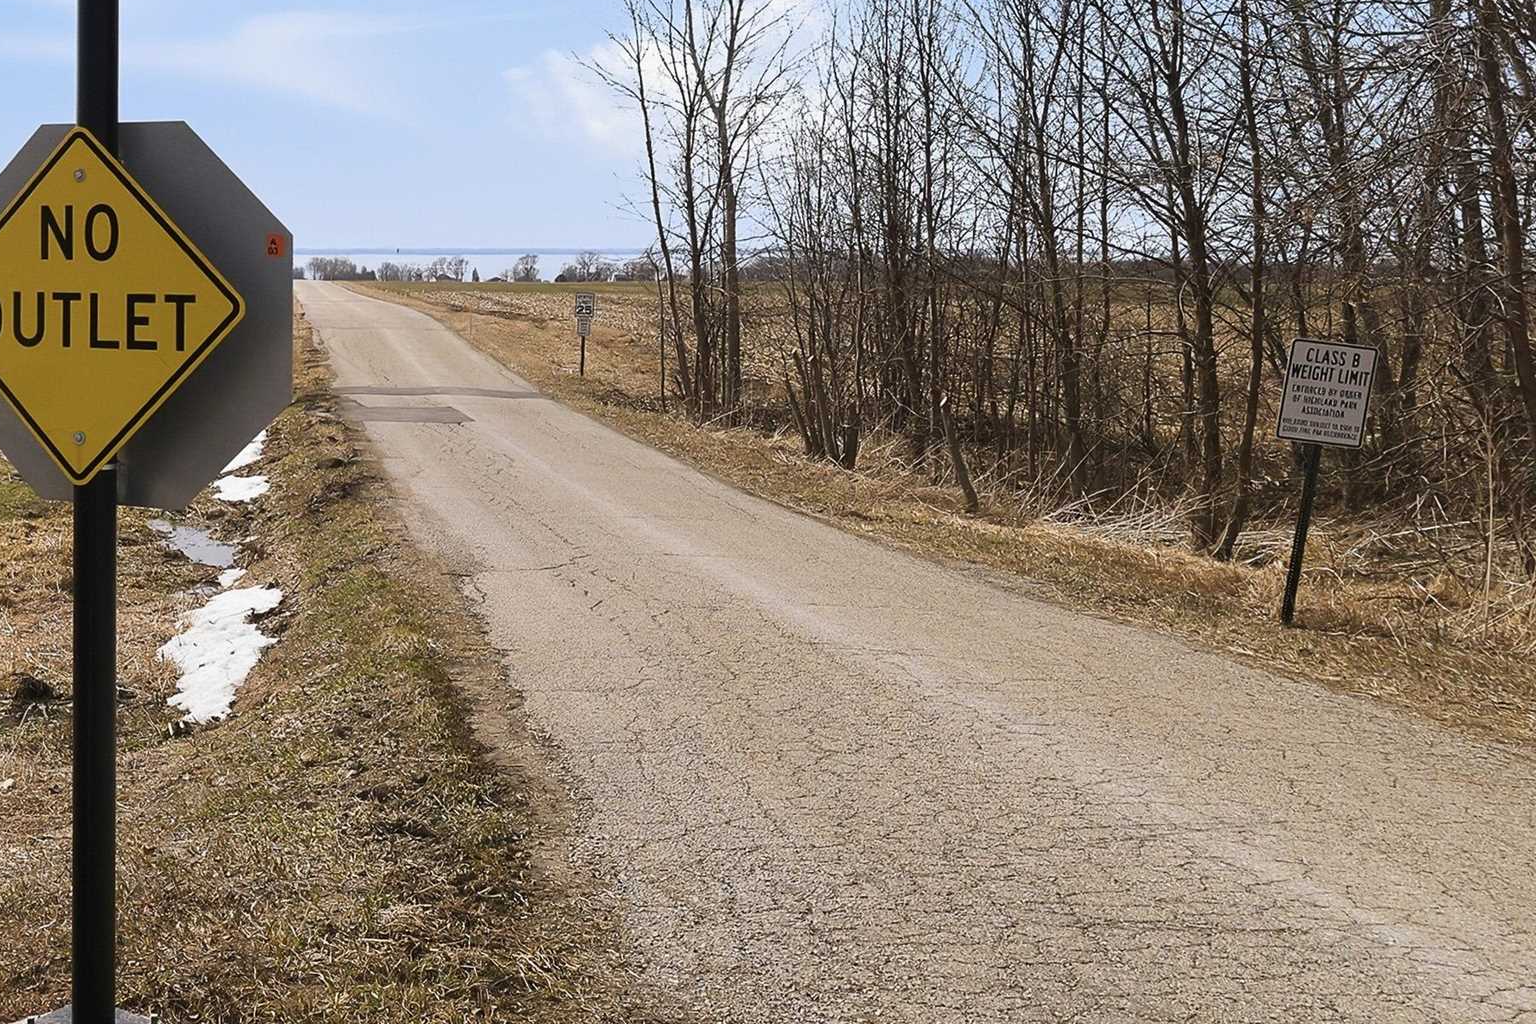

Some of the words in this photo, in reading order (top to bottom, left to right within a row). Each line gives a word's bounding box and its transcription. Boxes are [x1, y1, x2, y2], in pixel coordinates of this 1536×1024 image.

[40, 204, 119, 262] NO
[576, 305, 592, 315] 25
[1306, 347, 1347, 367] CLASS
[1352, 353, 1361, 368] B
[1291, 363, 1336, 382] WEIGHT
[1337, 369, 1370, 387] LIMIT
